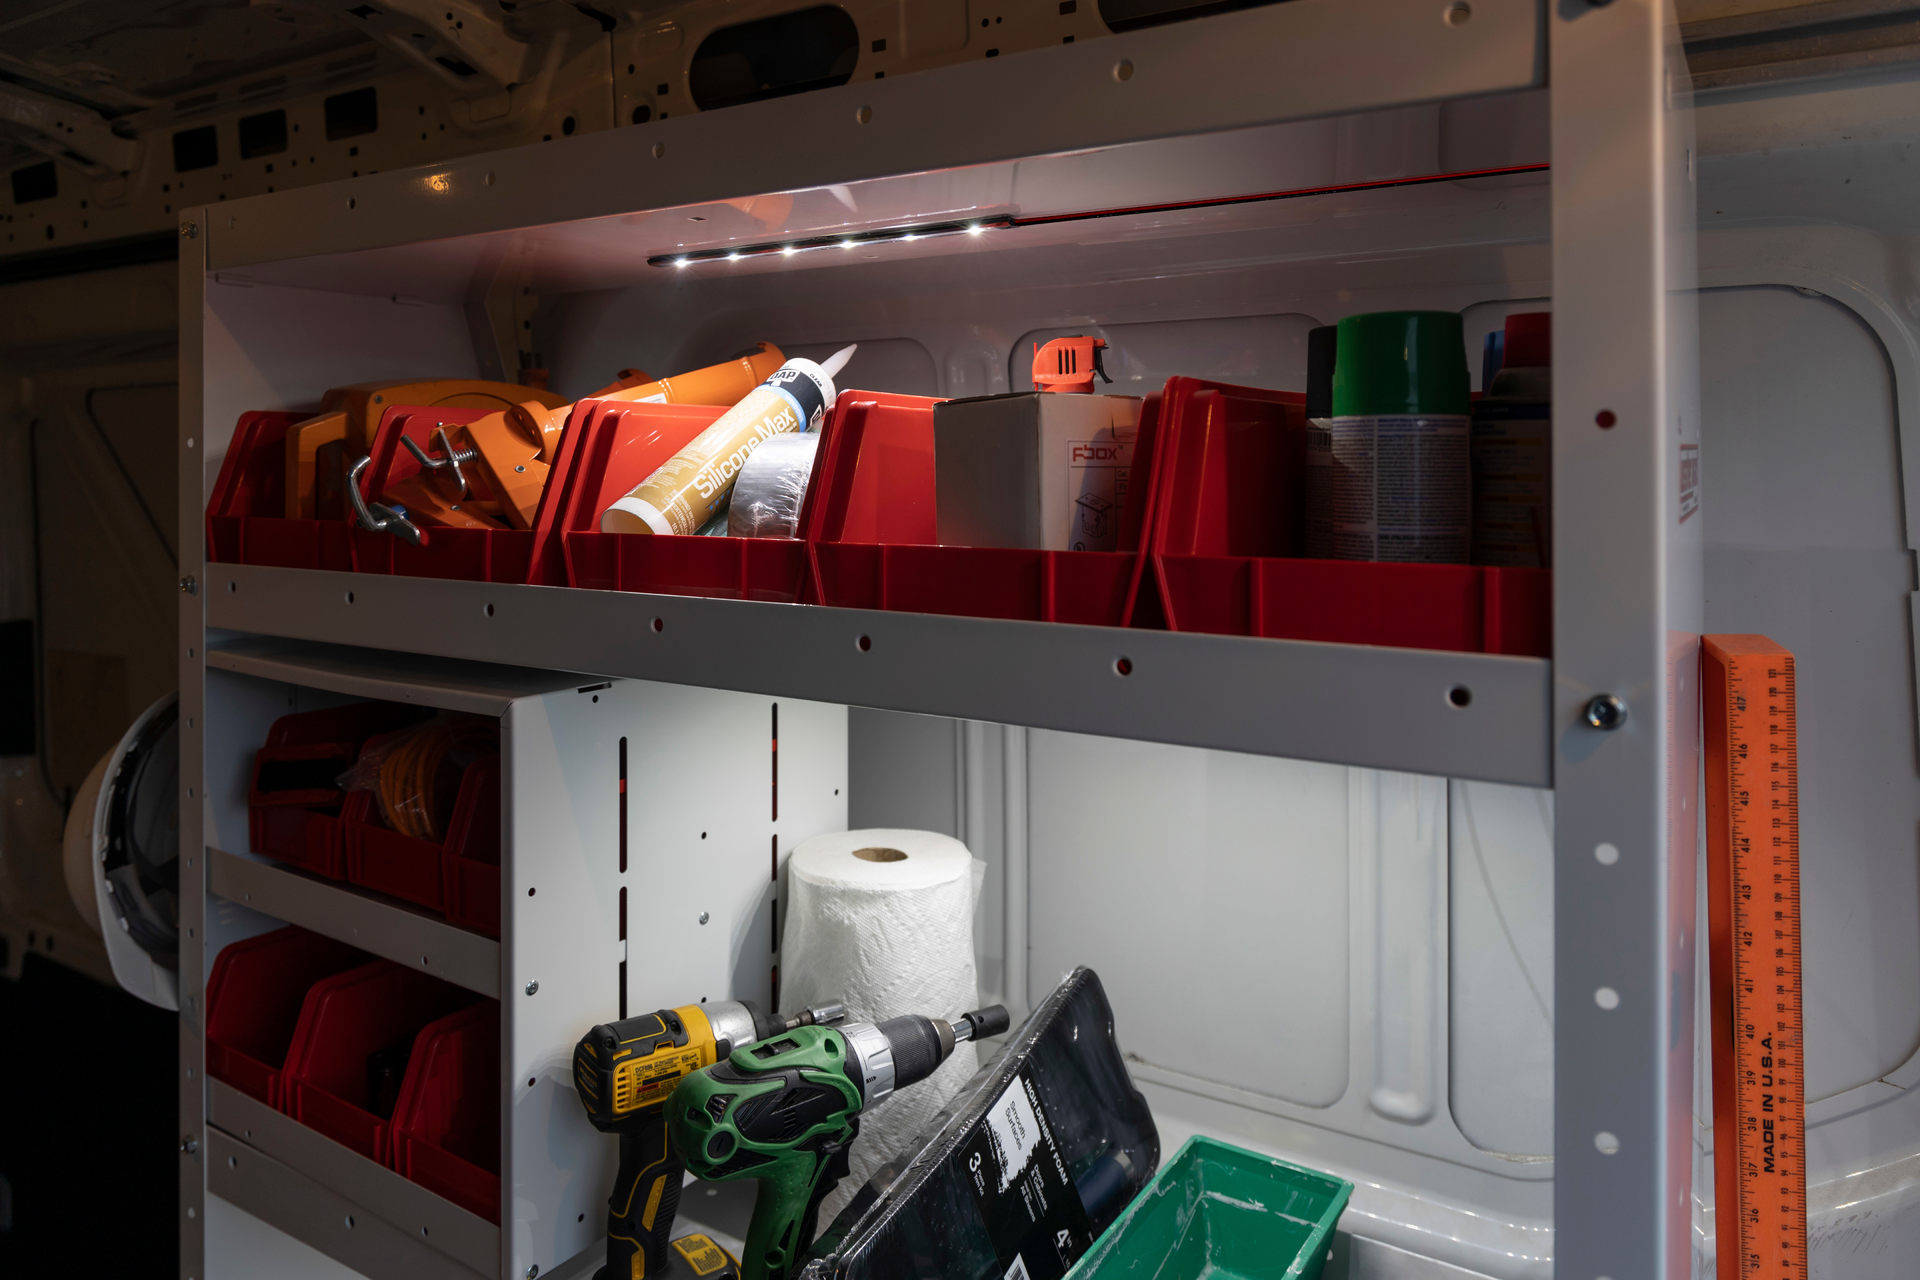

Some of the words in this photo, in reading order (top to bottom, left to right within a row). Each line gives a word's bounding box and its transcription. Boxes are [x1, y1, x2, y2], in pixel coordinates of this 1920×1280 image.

[810, 374, 822, 388] CLEAR
[785, 395, 804, 423] WINDOWS
[693, 436, 760, 499] Silicone
[1768, 668, 1777, 678] 121
[1769, 687, 1777, 697] 120
[1737, 696, 1746, 711] 47
[1769, 706, 1778, 716] 119
[1770, 725, 1778, 734] 118
[1738, 744, 1748, 758] 46
[1770, 744, 1779, 753] 117
[1771, 762, 1779, 772] 116
[1772, 781, 1780, 790] 115
[1739, 791, 1749, 805] 45
[1773, 818, 1781, 828] 113
[1741, 838, 1750, 852] 44
[1773, 837, 1781, 846] 112
[1774, 856, 1782, 865] 111
[1774, 874, 1782, 883] 110
[1742, 885, 1752, 899] 43
[1774, 892, 1783, 902] 109
[1774, 911, 1782, 920] 108
[1742, 932, 1752, 946] 42
[1775, 930, 1783, 939] 107
[1775, 948, 1784, 958] 106
[1744, 979, 1753, 992] 41
[1776, 985, 1784, 994] 104
[1777, 1003, 1785, 1013] 103
[1745, 1024, 1755, 1039] 40
[1777, 1022, 1785, 1031] 102
[1761, 1031, 1773, 1087] U.S.A.
[1778, 1058, 1786, 1068] 100
[1746, 1071, 1756, 1085] 39
[1762, 1094, 1773, 1112] IN
[1010, 1101, 1026, 1139] Smooth
[1747, 1117, 1757, 1131] 38
[1006, 1108, 1022, 1150] Surfaces
[1025, 1078, 1038, 1107] HIGH
[1036, 1106, 1056, 1151] DENSITY
[1053, 1152, 1068, 1186] FOAM
[1763, 1119, 1775, 1173] MADE
[969, 1152, 981, 1172] 3
[1034, 1164, 1044, 1188] Doors
[1748, 1163, 1758, 1177] 37
[1034, 1176, 1047, 1210] Cabinets
[1024, 1195, 1036, 1222] Sheens
[1749, 1209, 1759, 1222] 36
[1057, 1229, 1069, 1248] 4
[1066, 1236, 1072, 1248] in
[1750, 1254, 1760, 1268] 35
